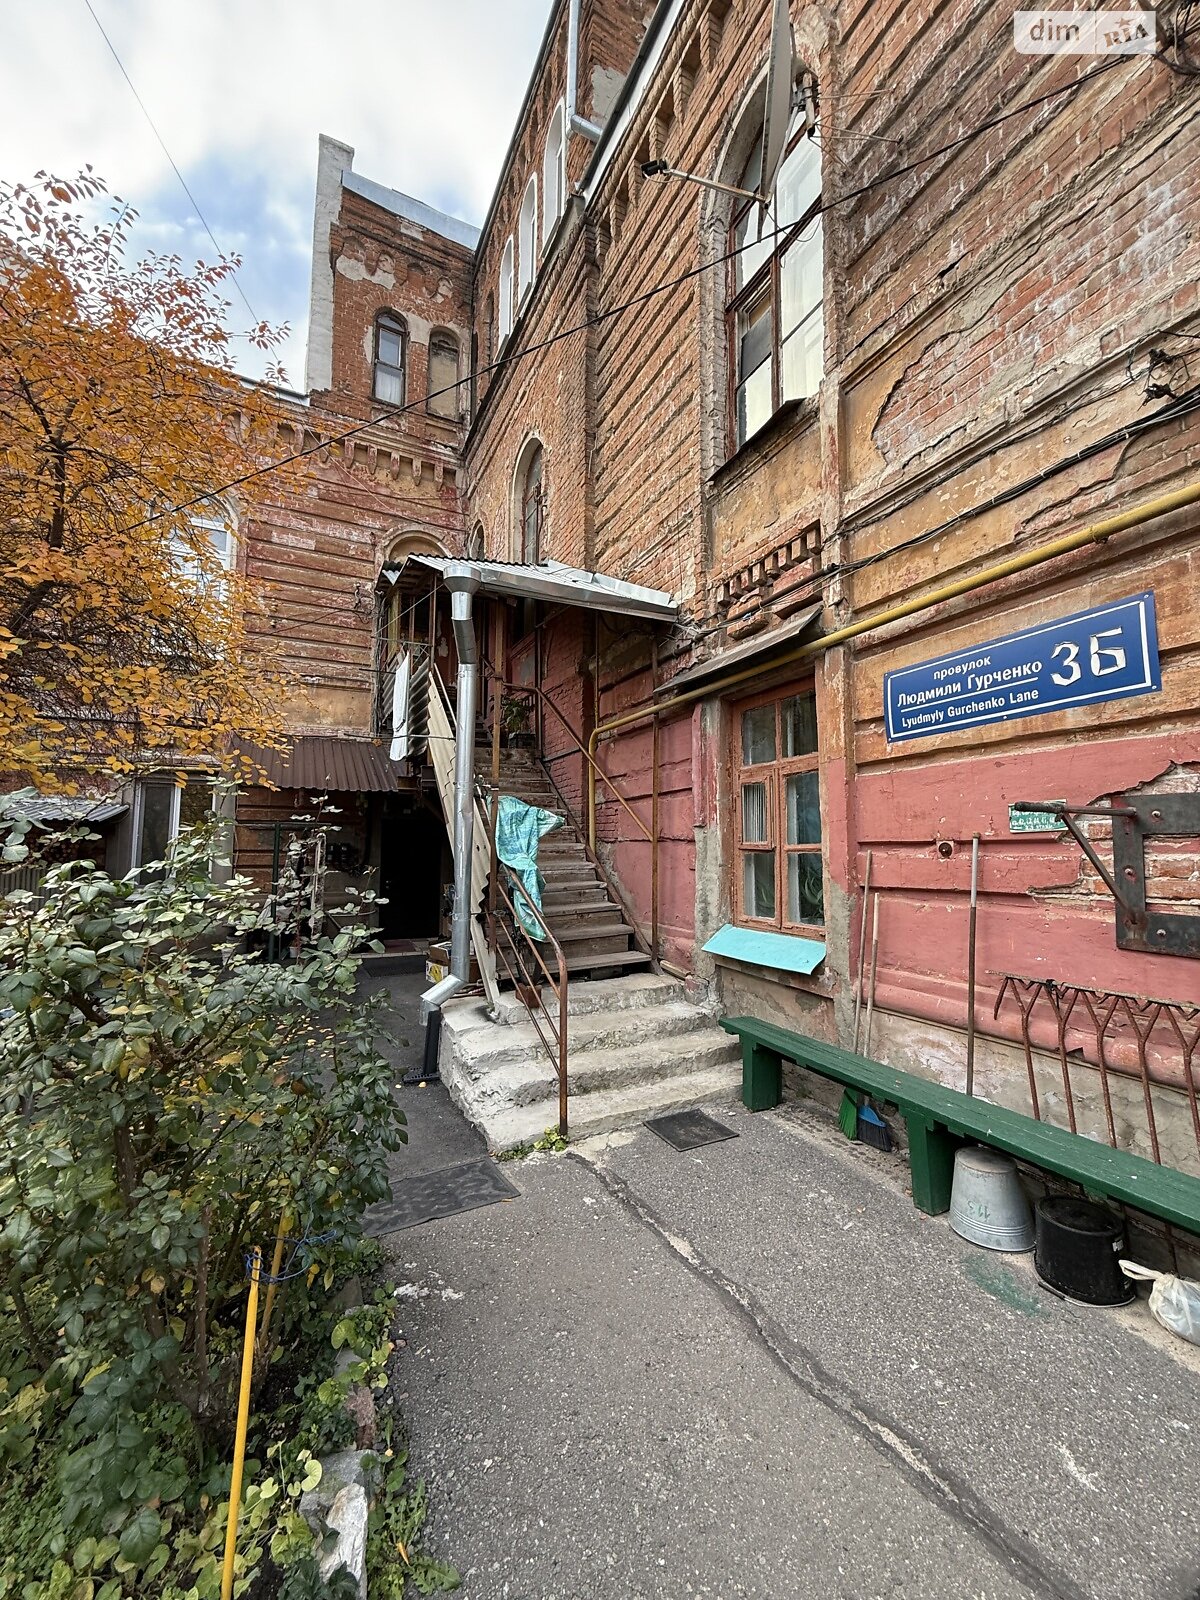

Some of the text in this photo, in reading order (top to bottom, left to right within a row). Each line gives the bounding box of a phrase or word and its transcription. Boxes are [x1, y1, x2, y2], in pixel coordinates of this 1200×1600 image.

[933, 656, 991, 680] провулок
[897, 682, 961, 707] Людмили
[902, 689, 1039, 728] Lyudmyly Gurchenko Lane
